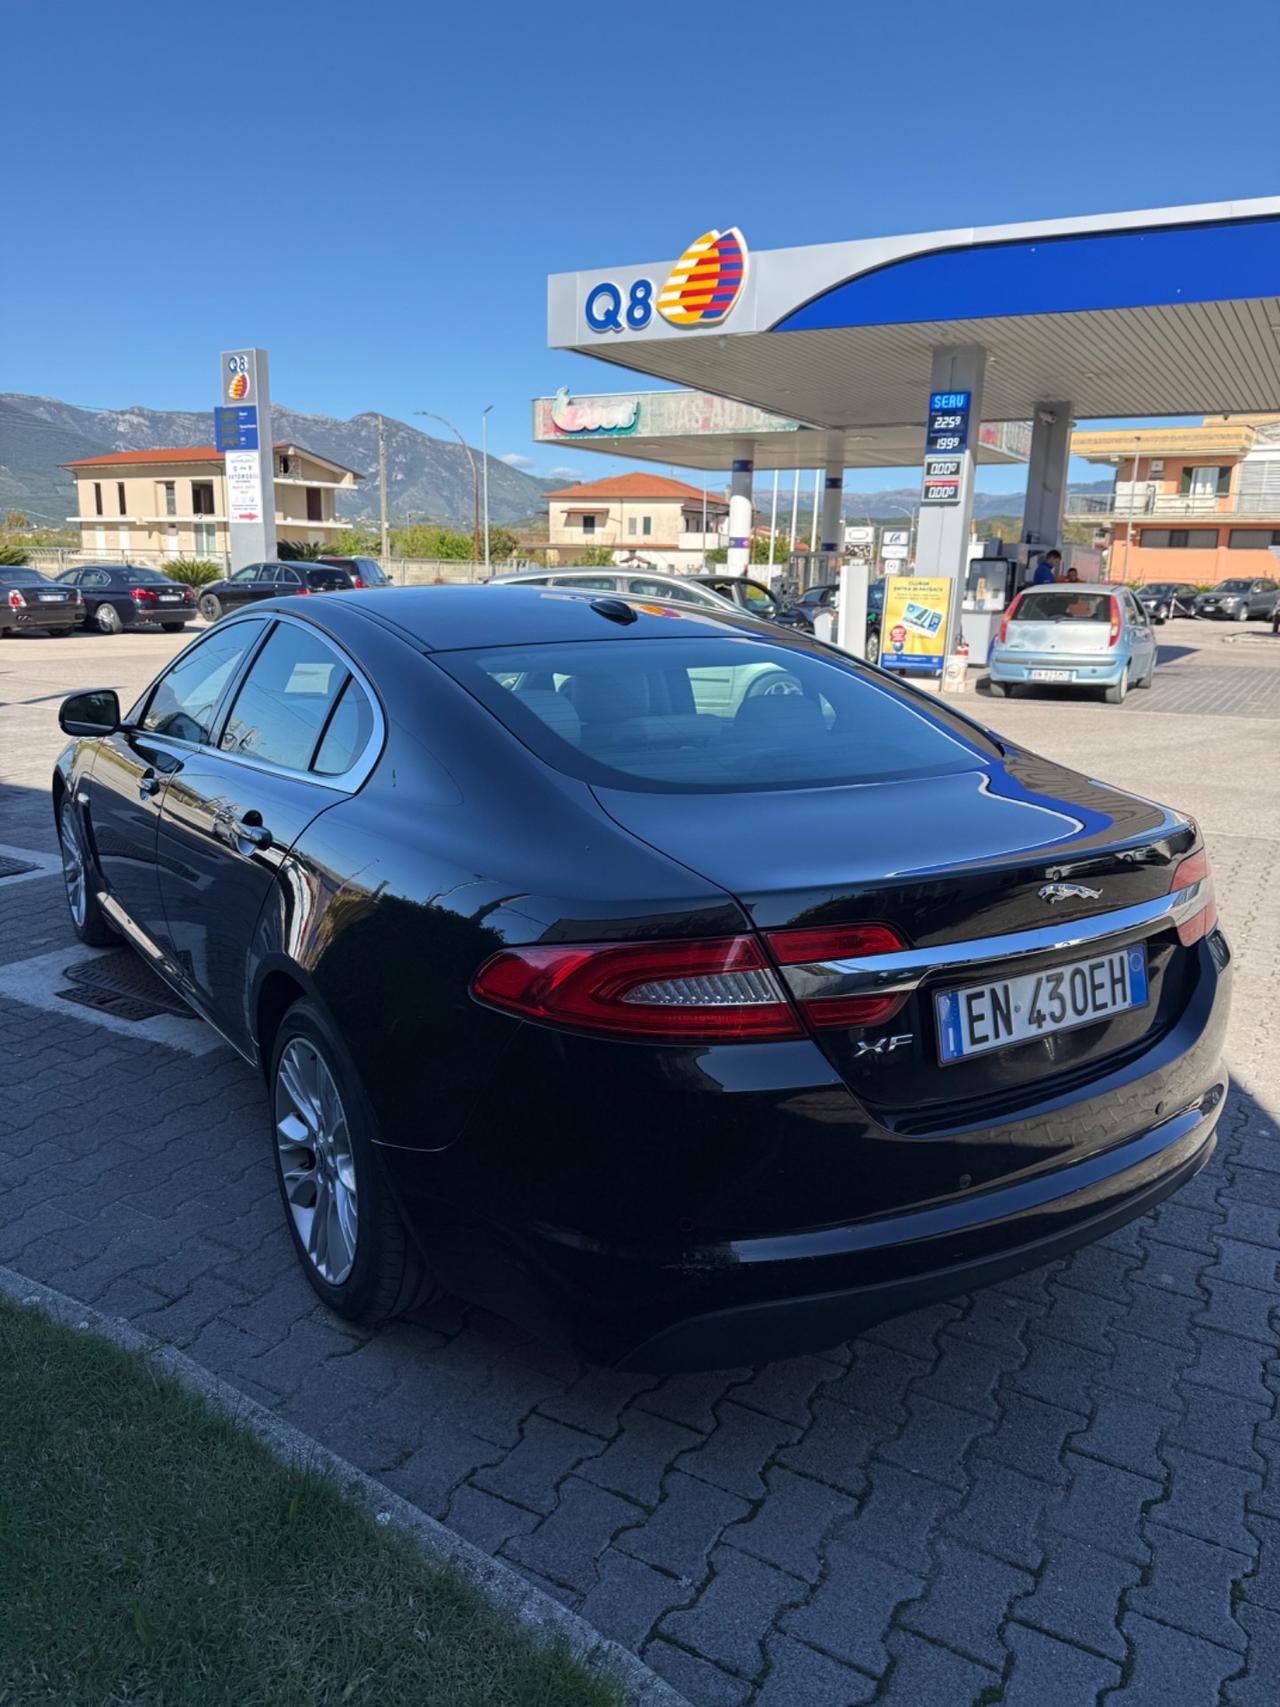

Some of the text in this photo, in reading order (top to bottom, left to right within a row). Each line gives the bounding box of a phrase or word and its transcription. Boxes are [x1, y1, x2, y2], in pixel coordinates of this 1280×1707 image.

[585, 279, 654, 333] Q8
[228, 355, 249, 374] Q8
[933, 394, 965, 408] SERV
[966, 955, 1128, 1046] EN 430EH
[853, 1033, 914, 1058] XF
